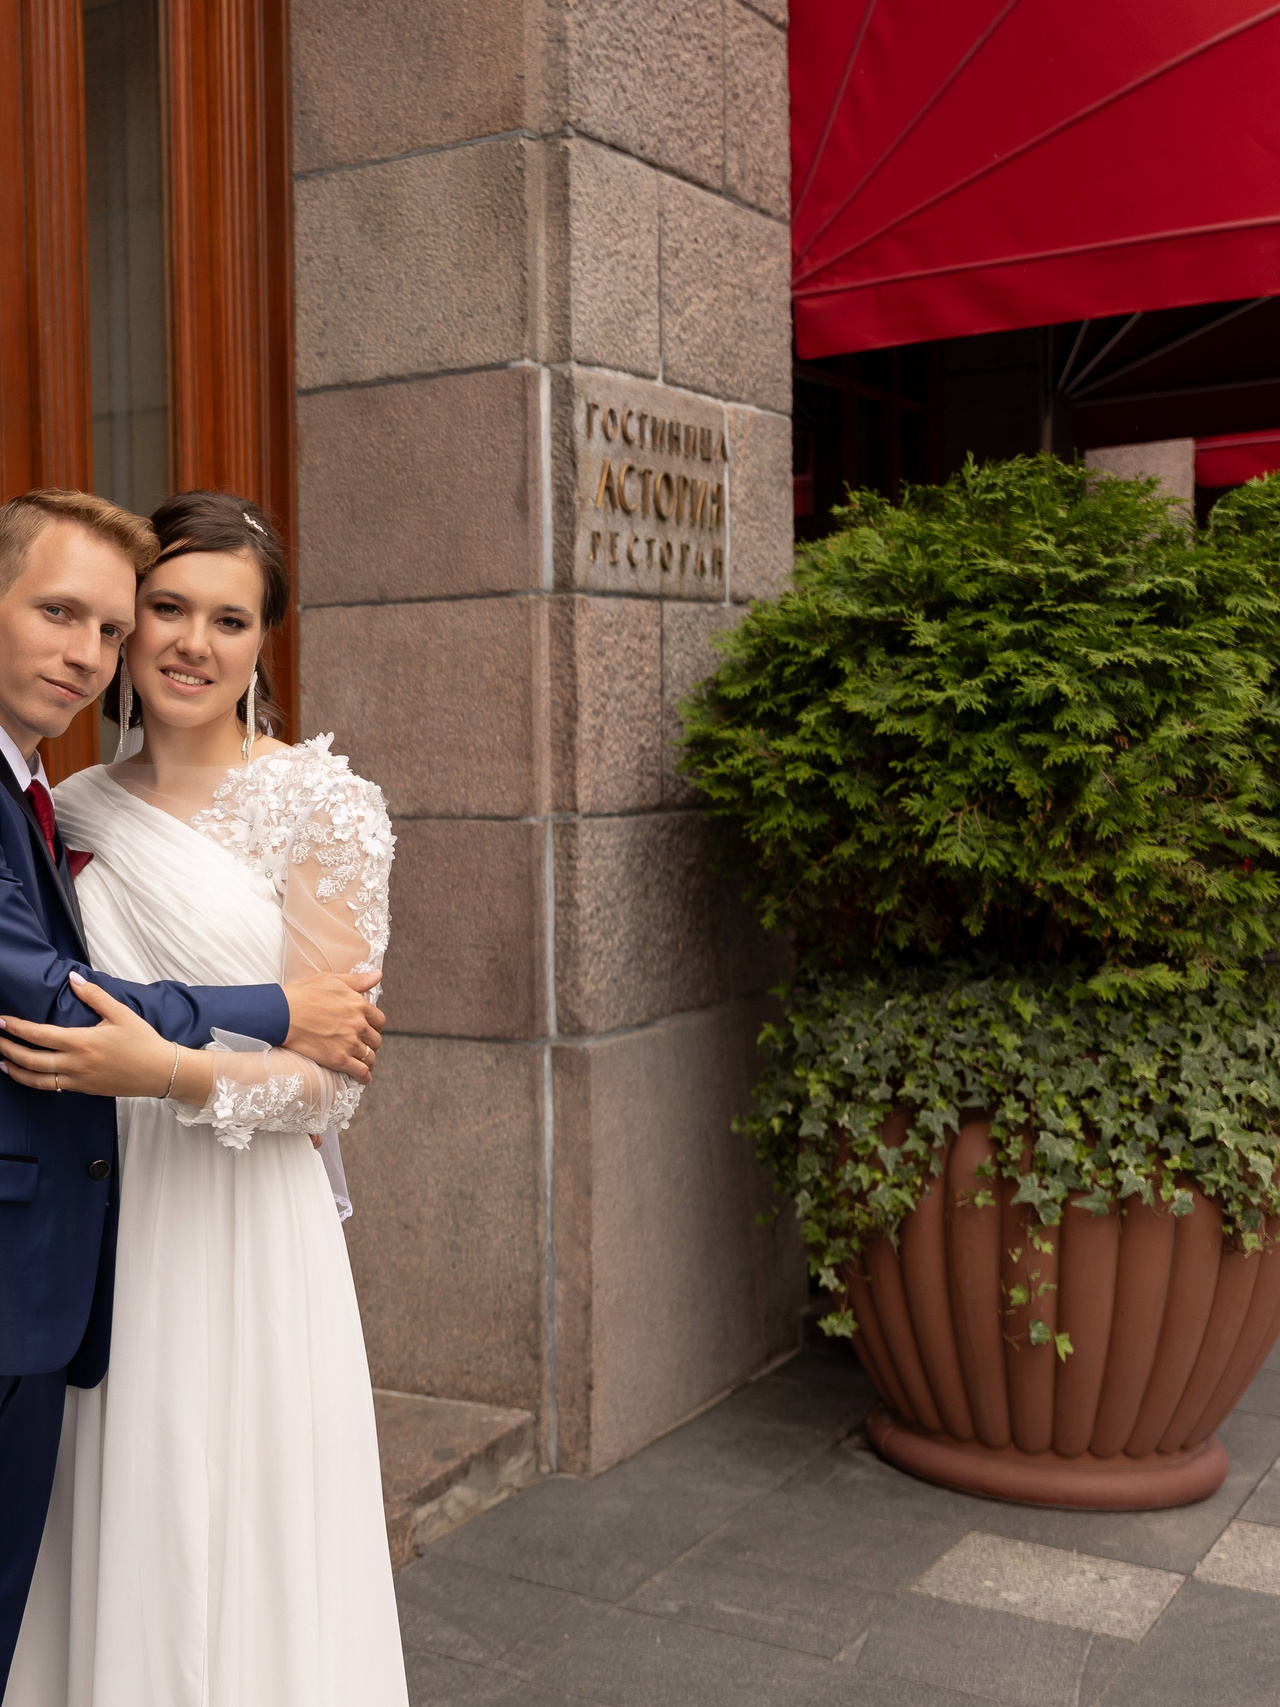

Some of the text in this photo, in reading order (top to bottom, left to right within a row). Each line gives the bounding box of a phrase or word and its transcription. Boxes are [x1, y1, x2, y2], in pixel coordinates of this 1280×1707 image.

[586, 402, 728, 462] ГОСТИНИЦА
[595, 459, 724, 530] АСТОРИЯ
[590, 531, 724, 579] РЕСТОРАН
